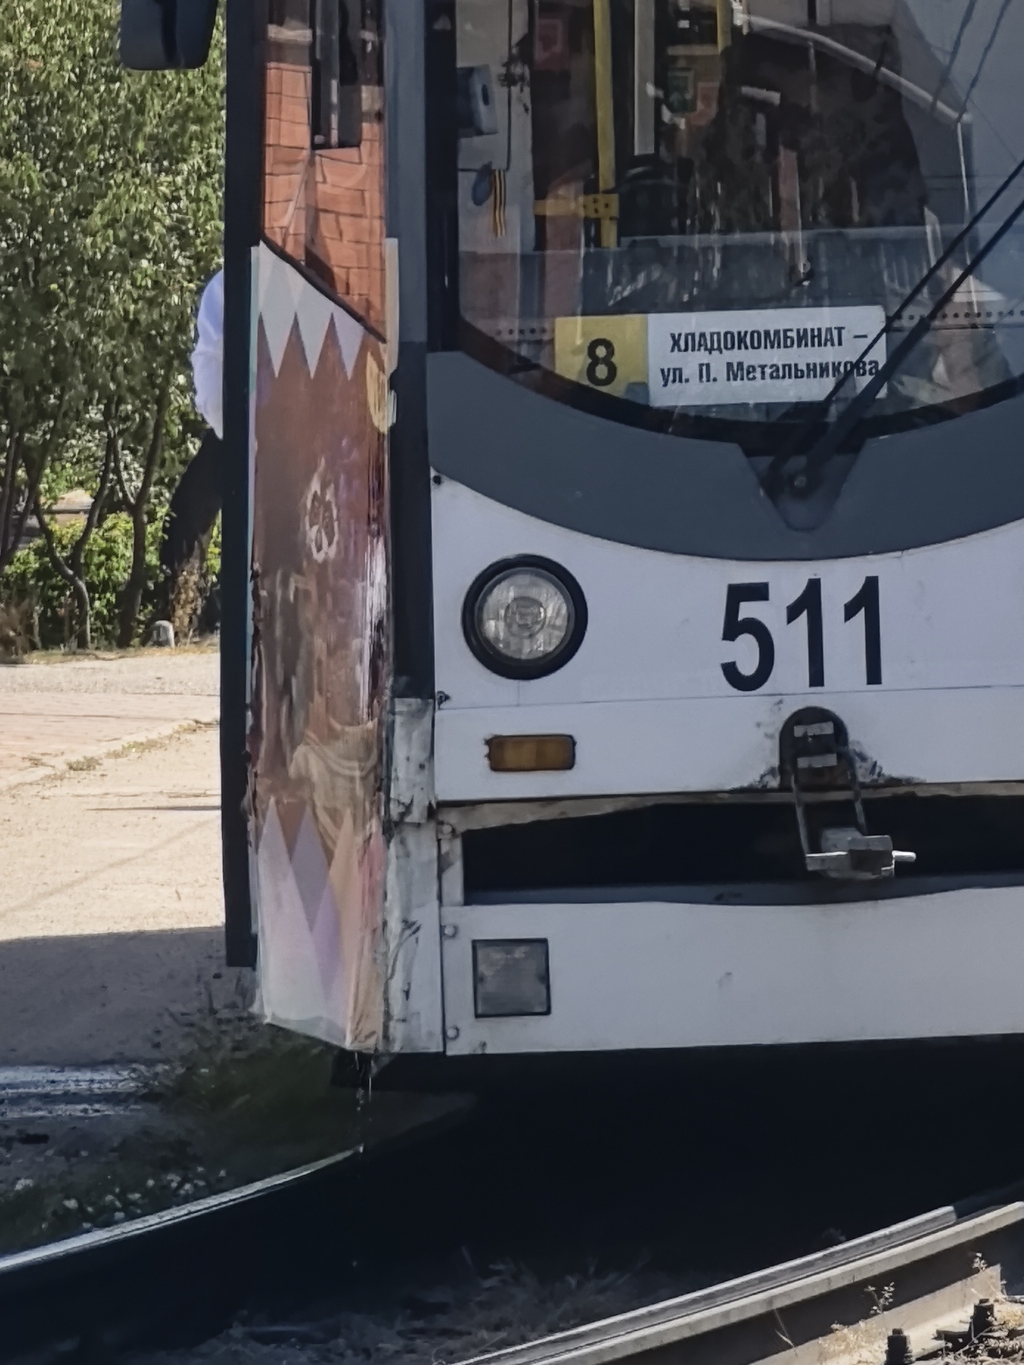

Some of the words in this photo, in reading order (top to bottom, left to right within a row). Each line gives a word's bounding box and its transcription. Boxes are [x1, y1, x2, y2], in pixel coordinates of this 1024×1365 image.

[669, 326, 846, 355] ХЛАДОКОМБИНАТ
[585, 338, 618, 387] 8
[660, 366, 690, 387] ул.
[698, 363, 718, 383] П.
[720, 575, 883, 692] 511
